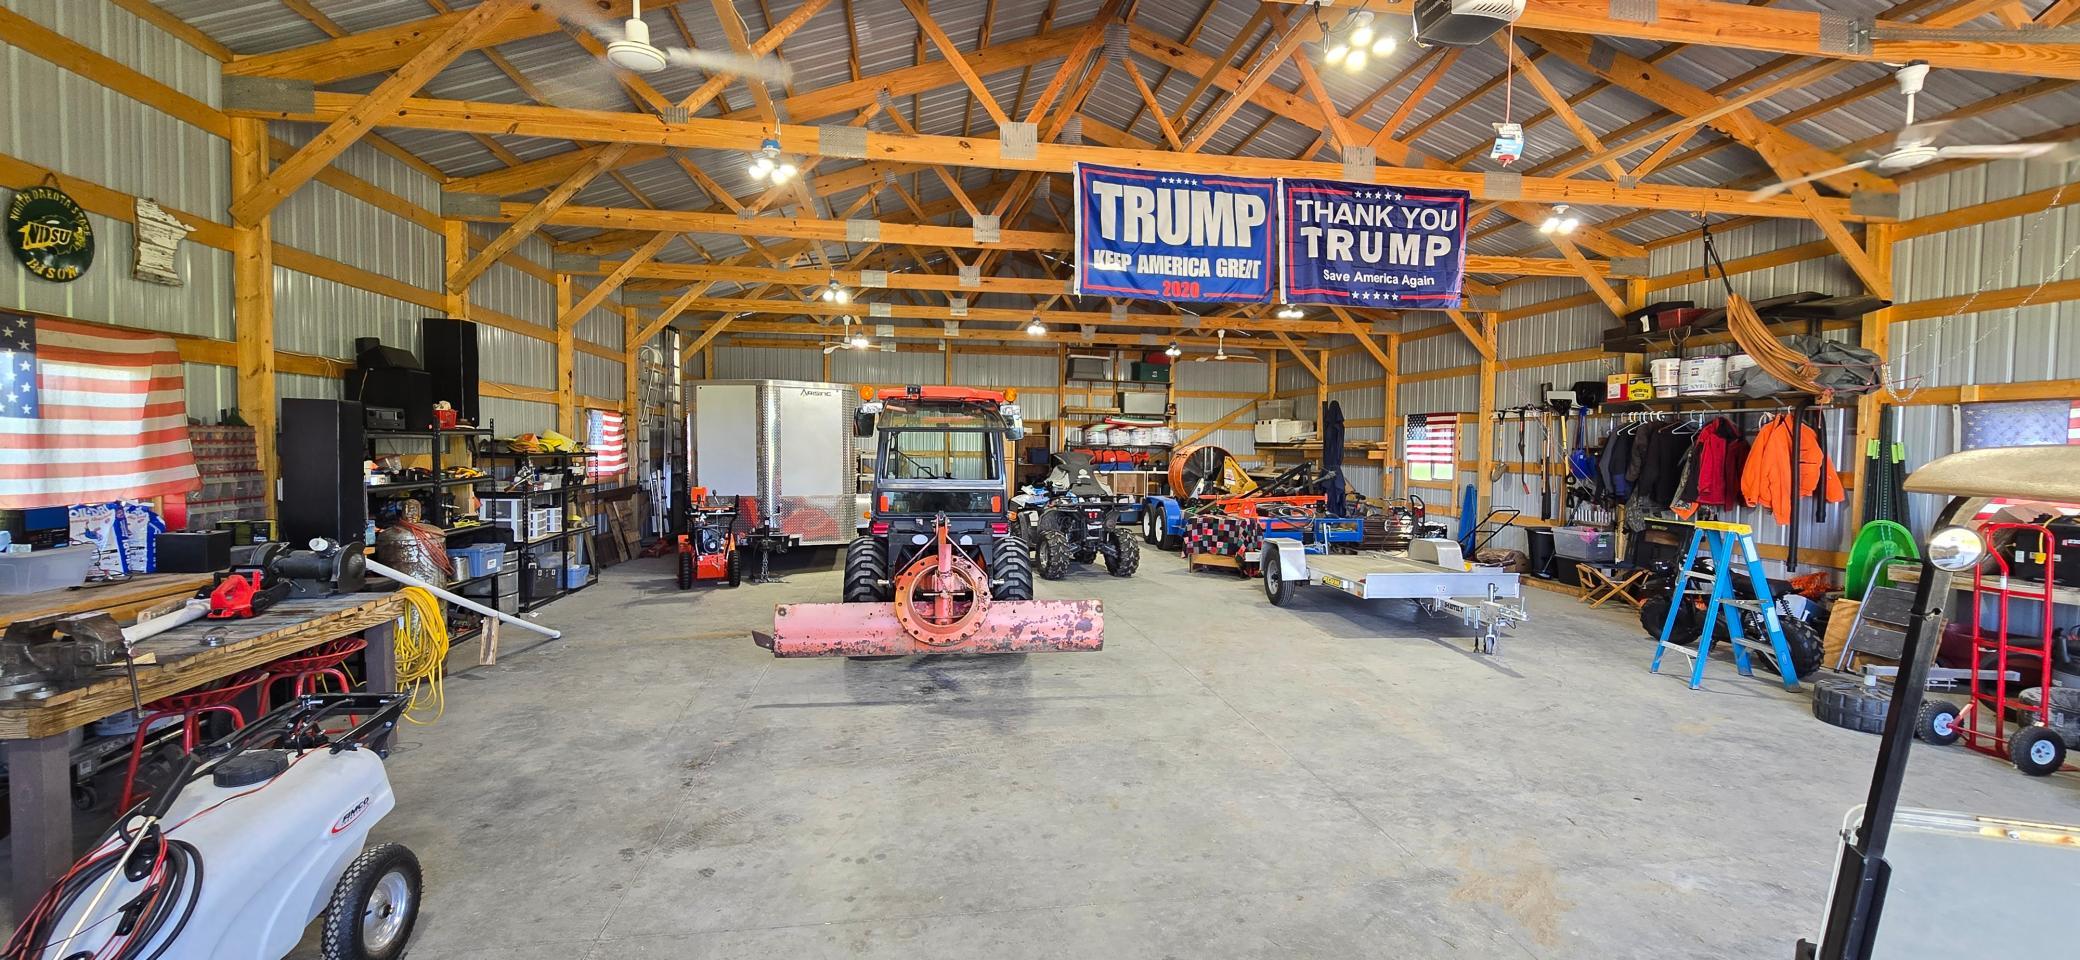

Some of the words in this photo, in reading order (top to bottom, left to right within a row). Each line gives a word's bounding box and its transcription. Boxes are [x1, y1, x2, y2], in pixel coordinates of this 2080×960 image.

[10, 193, 32, 221] NORTH
[32, 188, 71, 208] DAKOTA
[71, 206, 91, 236] STATE
[1092, 180, 1267, 248] TRUMP
[1295, 199, 1394, 228] THANK
[1401, 207, 1457, 232] YOU
[28, 221, 73, 246] NDSU
[1300, 226, 1453, 267] TRUMP
[26, 257, 79, 280] BISON
[1093, 249, 1132, 272] KEEP
[1137, 254, 1211, 278] AMERICA
[1162, 279, 1200, 298] 2020
[1323, 268, 1350, 281] Save
[1353, 271, 1399, 285] America
[1401, 275, 1435, 289] Again
